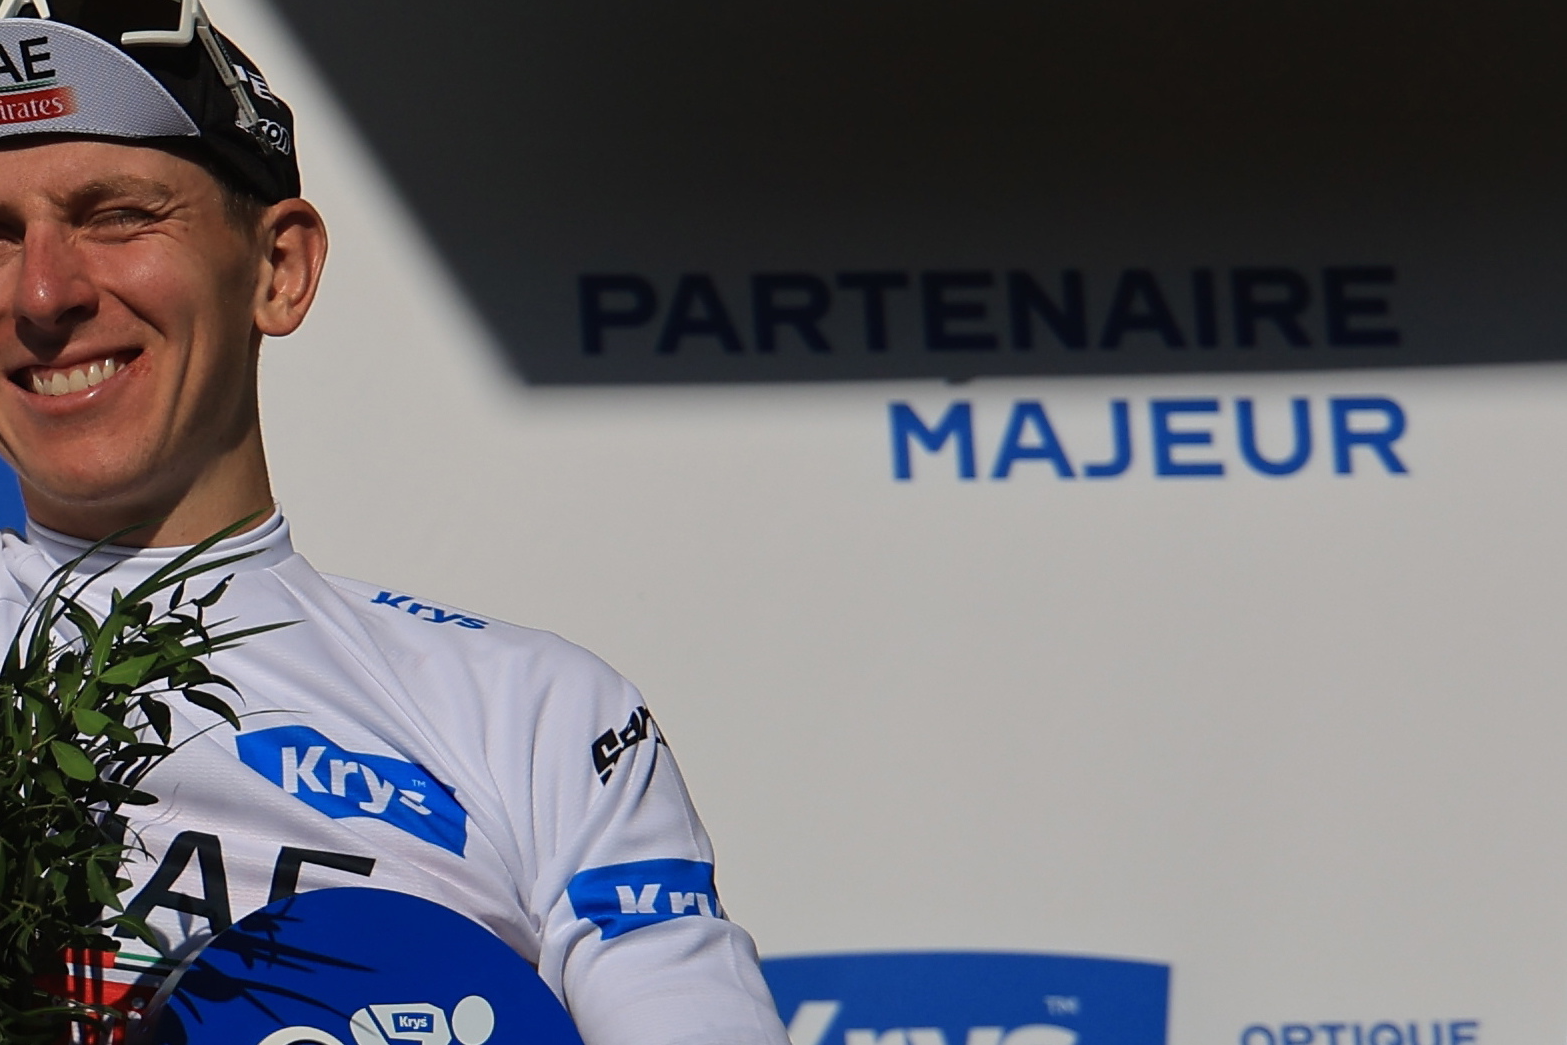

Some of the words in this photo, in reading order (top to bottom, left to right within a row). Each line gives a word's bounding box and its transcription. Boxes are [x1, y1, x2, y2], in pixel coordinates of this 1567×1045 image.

[579, 266, 1401, 356] PARTENAIRE
[888, 395, 1409, 481] MAJEUR
[370, 590, 490, 629] Krys
[281, 745, 432, 815] Krys
[398, 1014, 429, 1029] Krys
